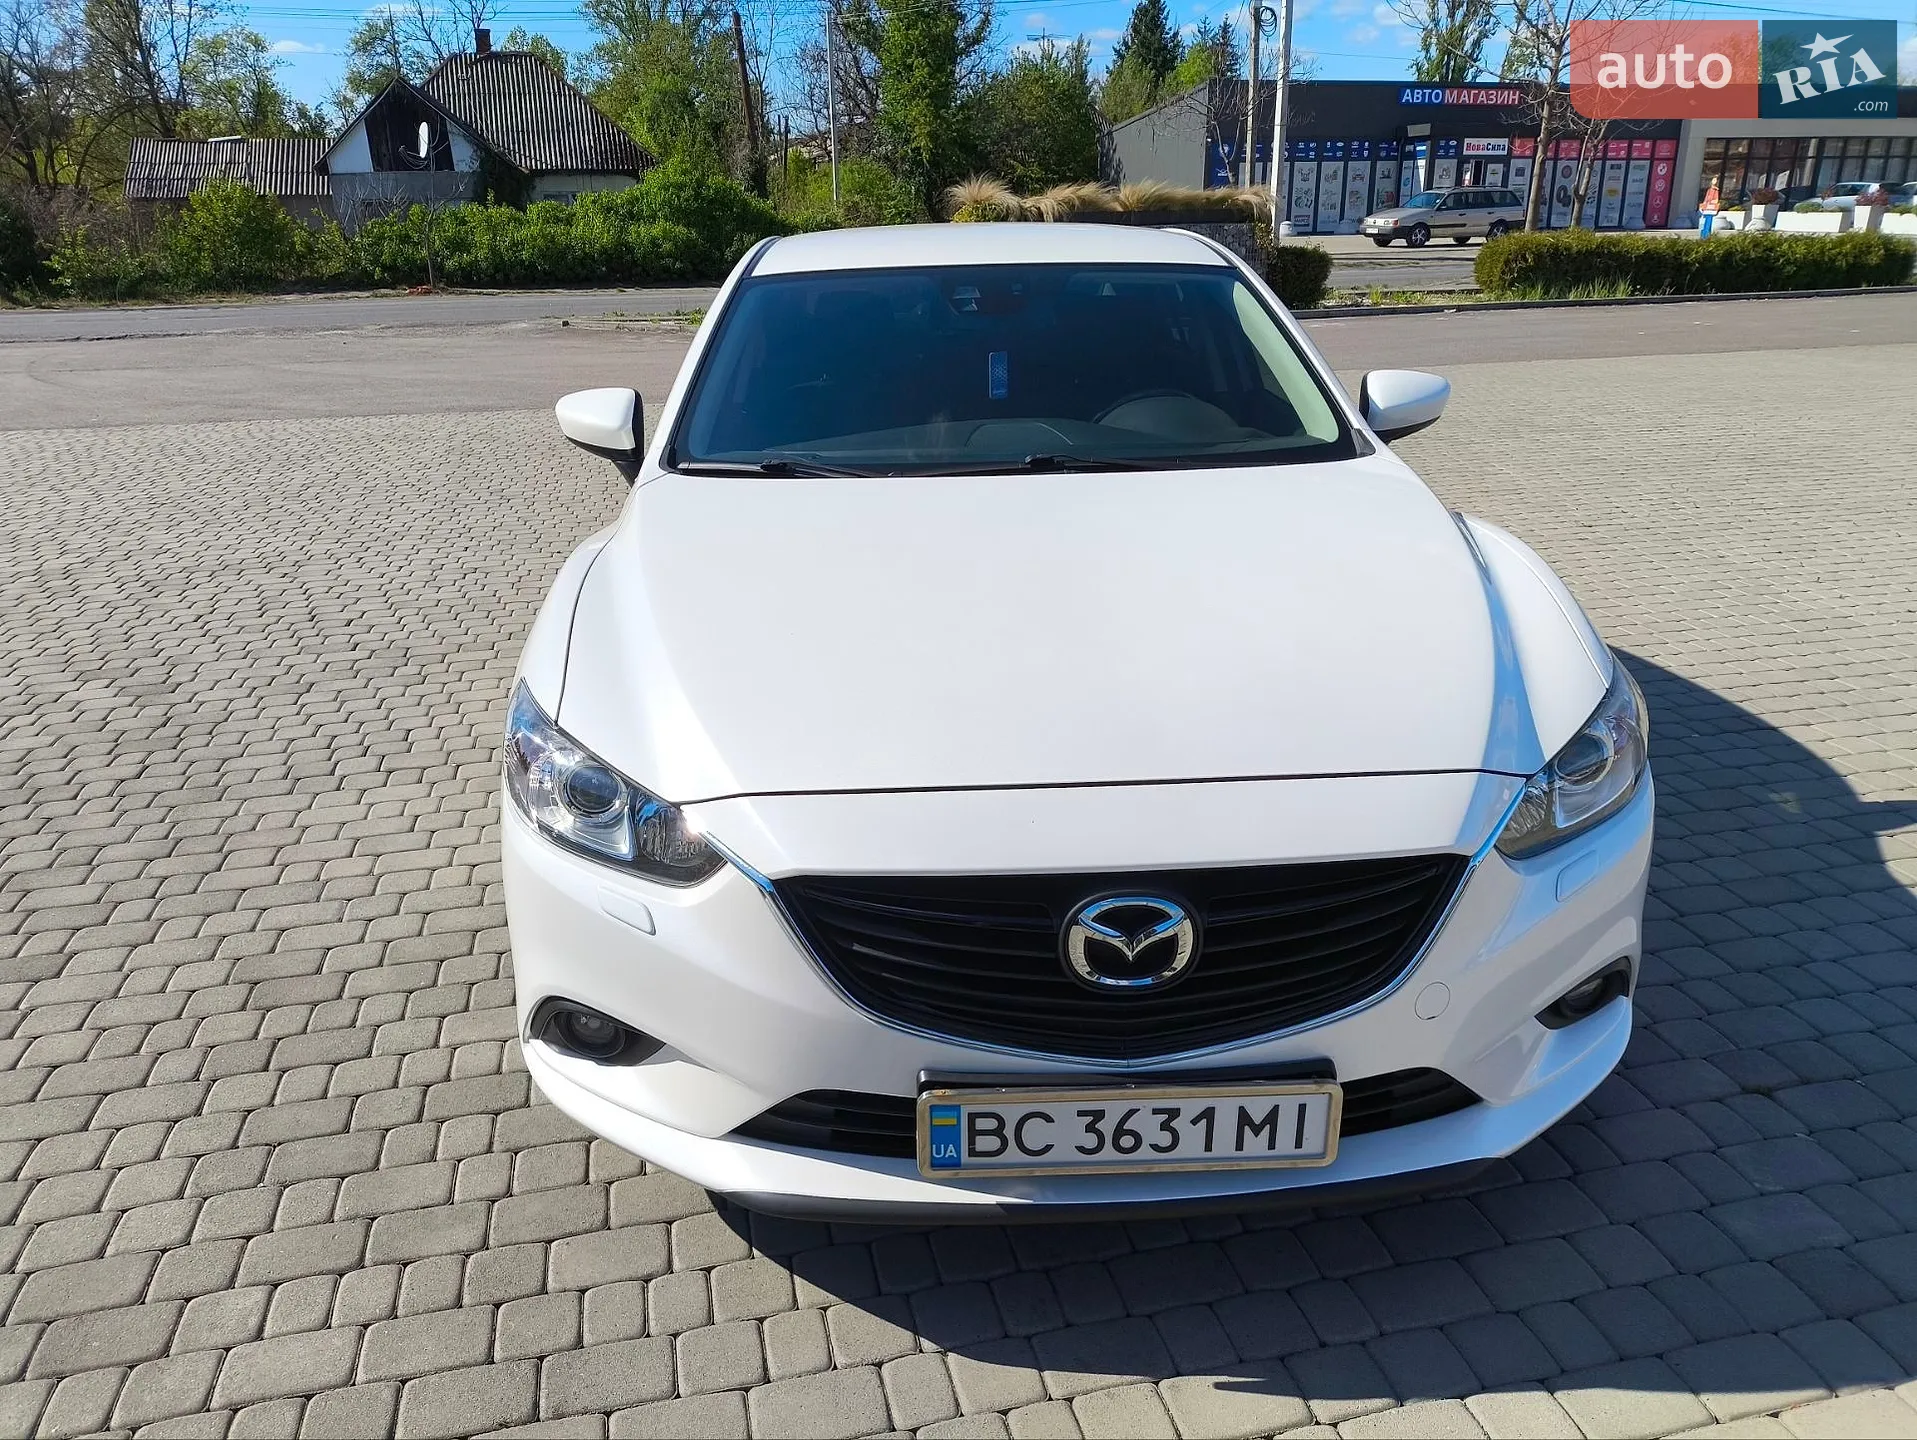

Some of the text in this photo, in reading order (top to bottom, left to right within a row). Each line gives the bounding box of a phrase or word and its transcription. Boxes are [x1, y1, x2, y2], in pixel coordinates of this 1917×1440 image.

[1401, 88, 1520, 105] АВТОМАГАЗИН
[966, 1103, 1307, 1158] BC 3631 MI
[932, 1143, 958, 1159] UA
